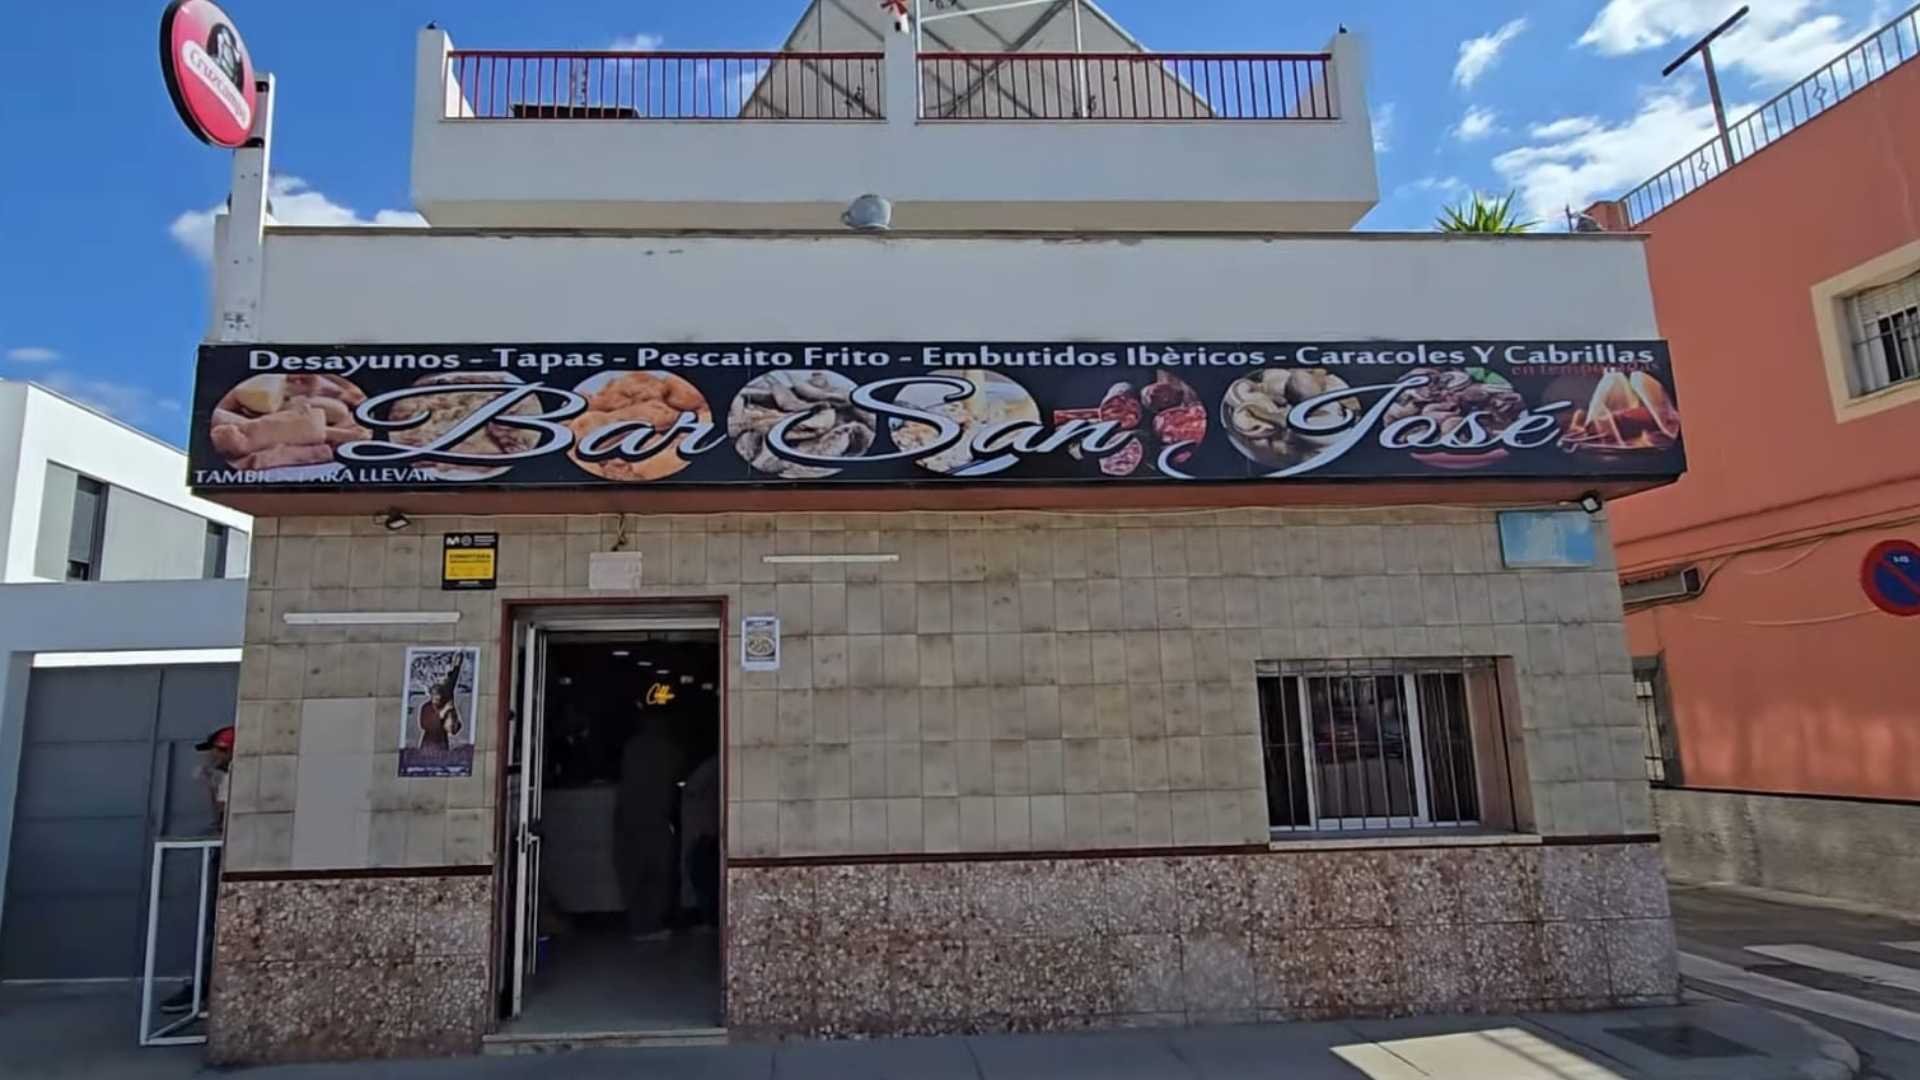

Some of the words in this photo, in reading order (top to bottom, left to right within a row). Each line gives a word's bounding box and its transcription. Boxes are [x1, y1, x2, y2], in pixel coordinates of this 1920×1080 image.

[249, 350, 460, 375] Desayunos
[493, 348, 604, 373] Tapas
[637, 347, 793, 368] Pescaito
[804, 347, 890, 368] Frito
[923, 346, 1117, 367] Embutidos
[1296, 345, 1465, 366] Caracoles
[1472, 345, 1494, 364] Y
[1504, 344, 1655, 365] Cabrillas
[336, 381, 727, 461] Bar
[767, 376, 1139, 463] San
[1157, 374, 1572, 479] José
[194, 469, 297, 484] TAMBI
[301, 467, 355, 483] ARA
[359, 467, 438, 482] LLEVAR
